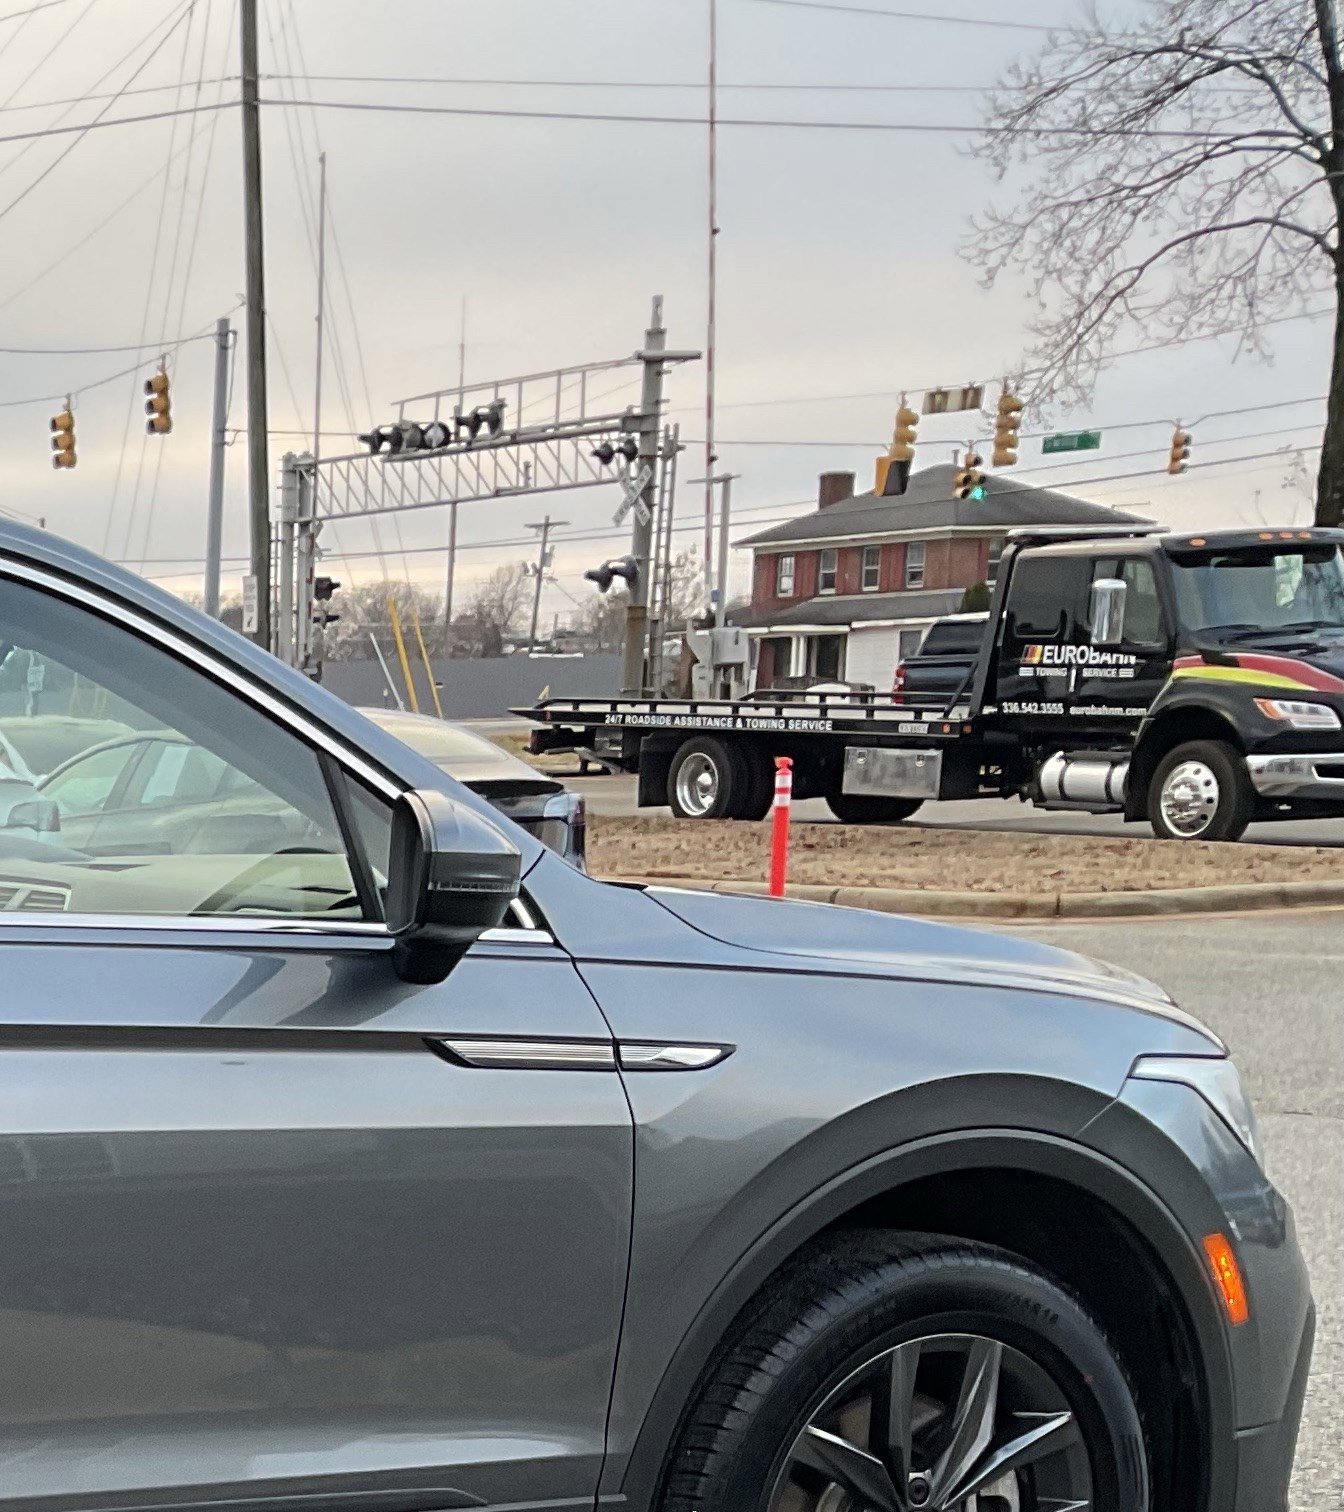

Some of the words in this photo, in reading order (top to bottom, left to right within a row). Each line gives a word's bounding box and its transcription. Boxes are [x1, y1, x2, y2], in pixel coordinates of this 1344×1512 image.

[1035, 667, 1068, 677] TOWING
[1082, 667, 1118, 678] SERVICE
[1002, 701, 1065, 715] 336.542.3555
[604, 714, 623, 725] 24/7
[624, 714, 672, 726] ROADSIDE
[673, 716, 733, 728] ASSISTANCE
[735, 717, 743, 728] &
[746, 718, 786, 730] TOWING
[788, 719, 834, 731] SERVICE
